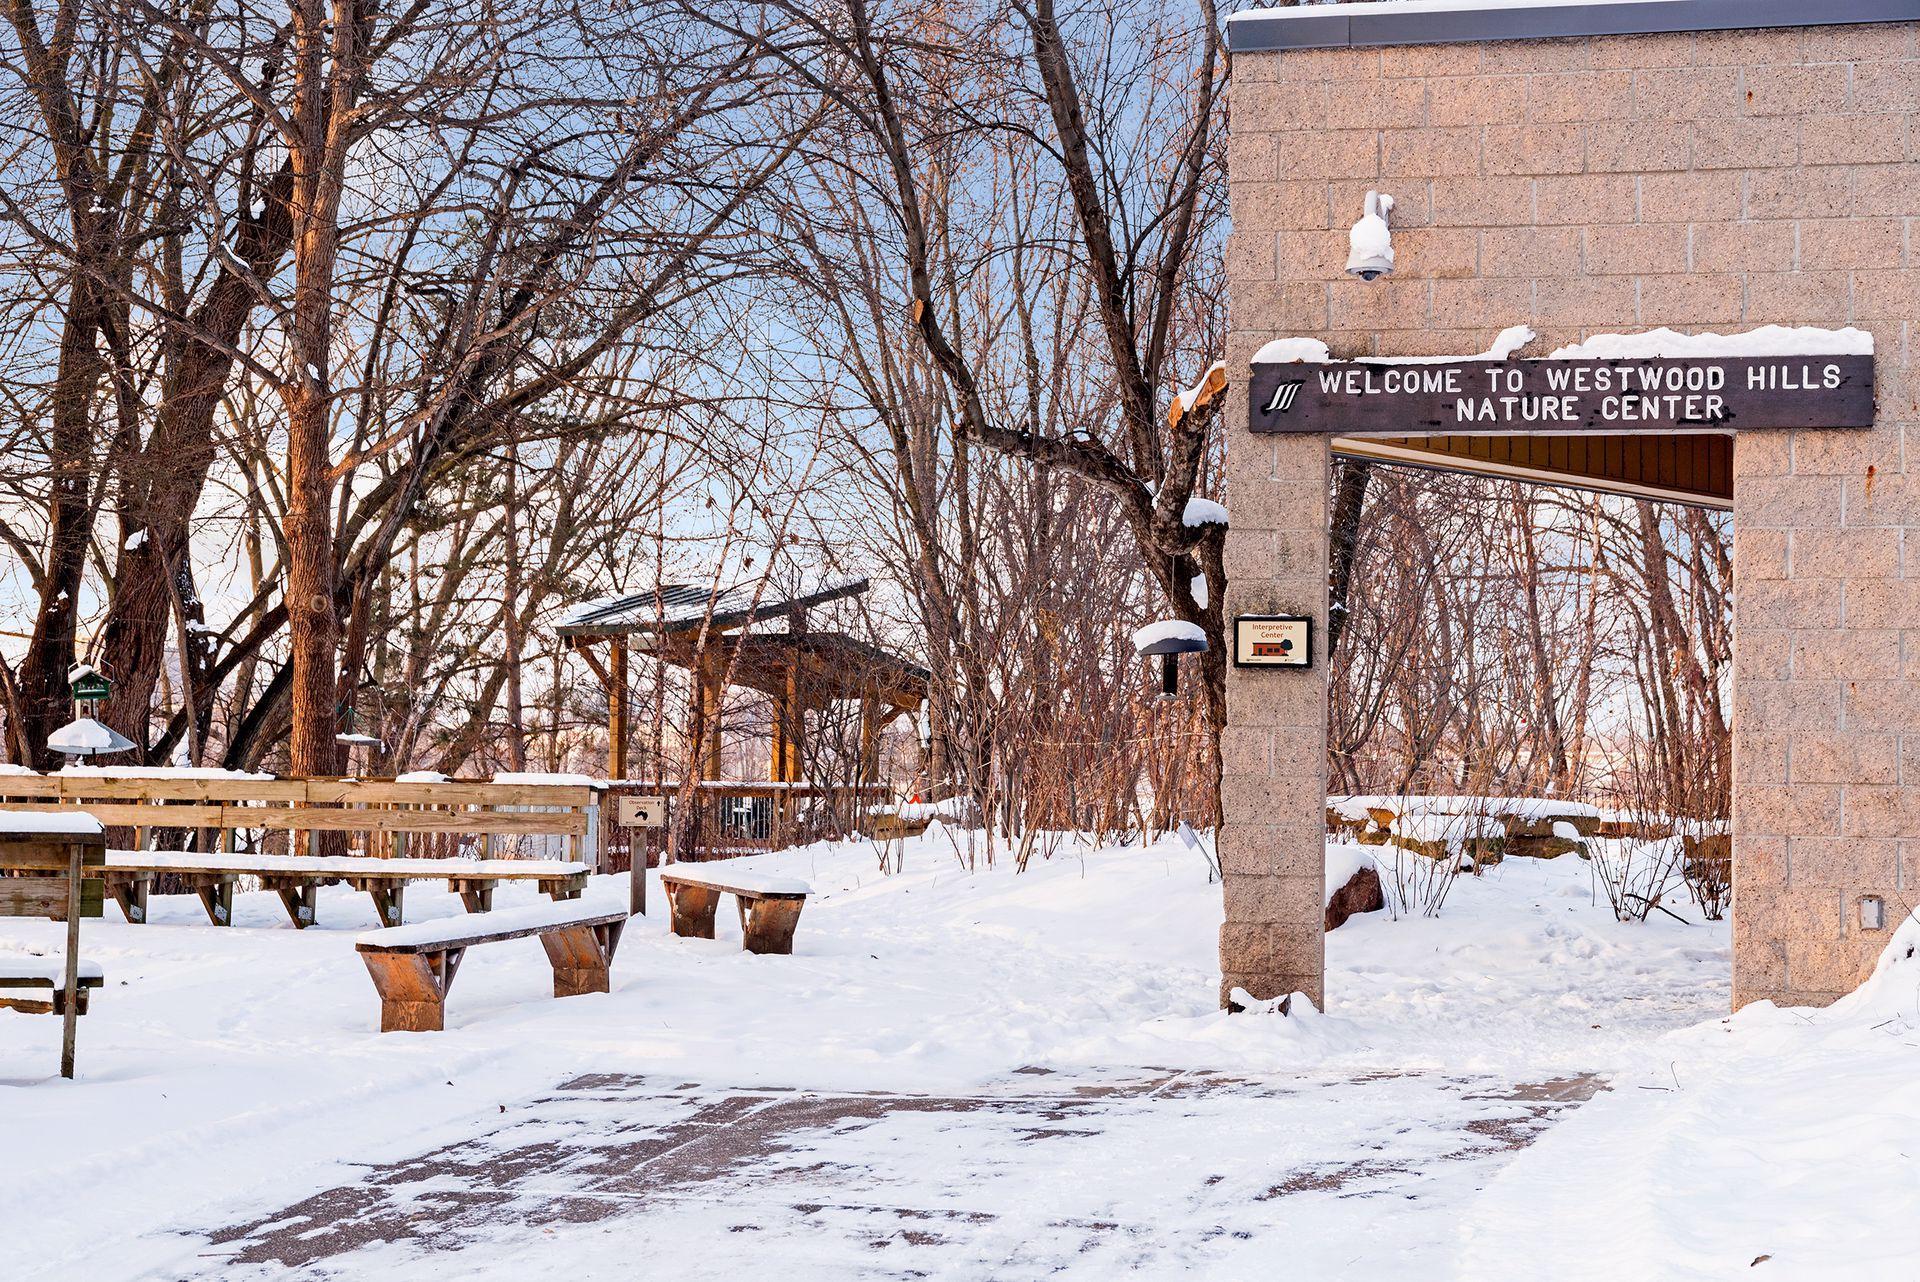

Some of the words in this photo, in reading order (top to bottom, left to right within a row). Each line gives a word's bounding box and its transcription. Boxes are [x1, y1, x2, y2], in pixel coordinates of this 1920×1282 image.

[1318, 368, 1462, 394] WELCOME
[1484, 368, 1523, 393] TO
[1546, 365, 1725, 392] WESTWOOD
[1747, 364, 1841, 390] HILLS
[1456, 395, 1580, 422] NATURE
[1601, 394, 1724, 421] CENTER
[1252, 623, 1293, 631] Interpretive
